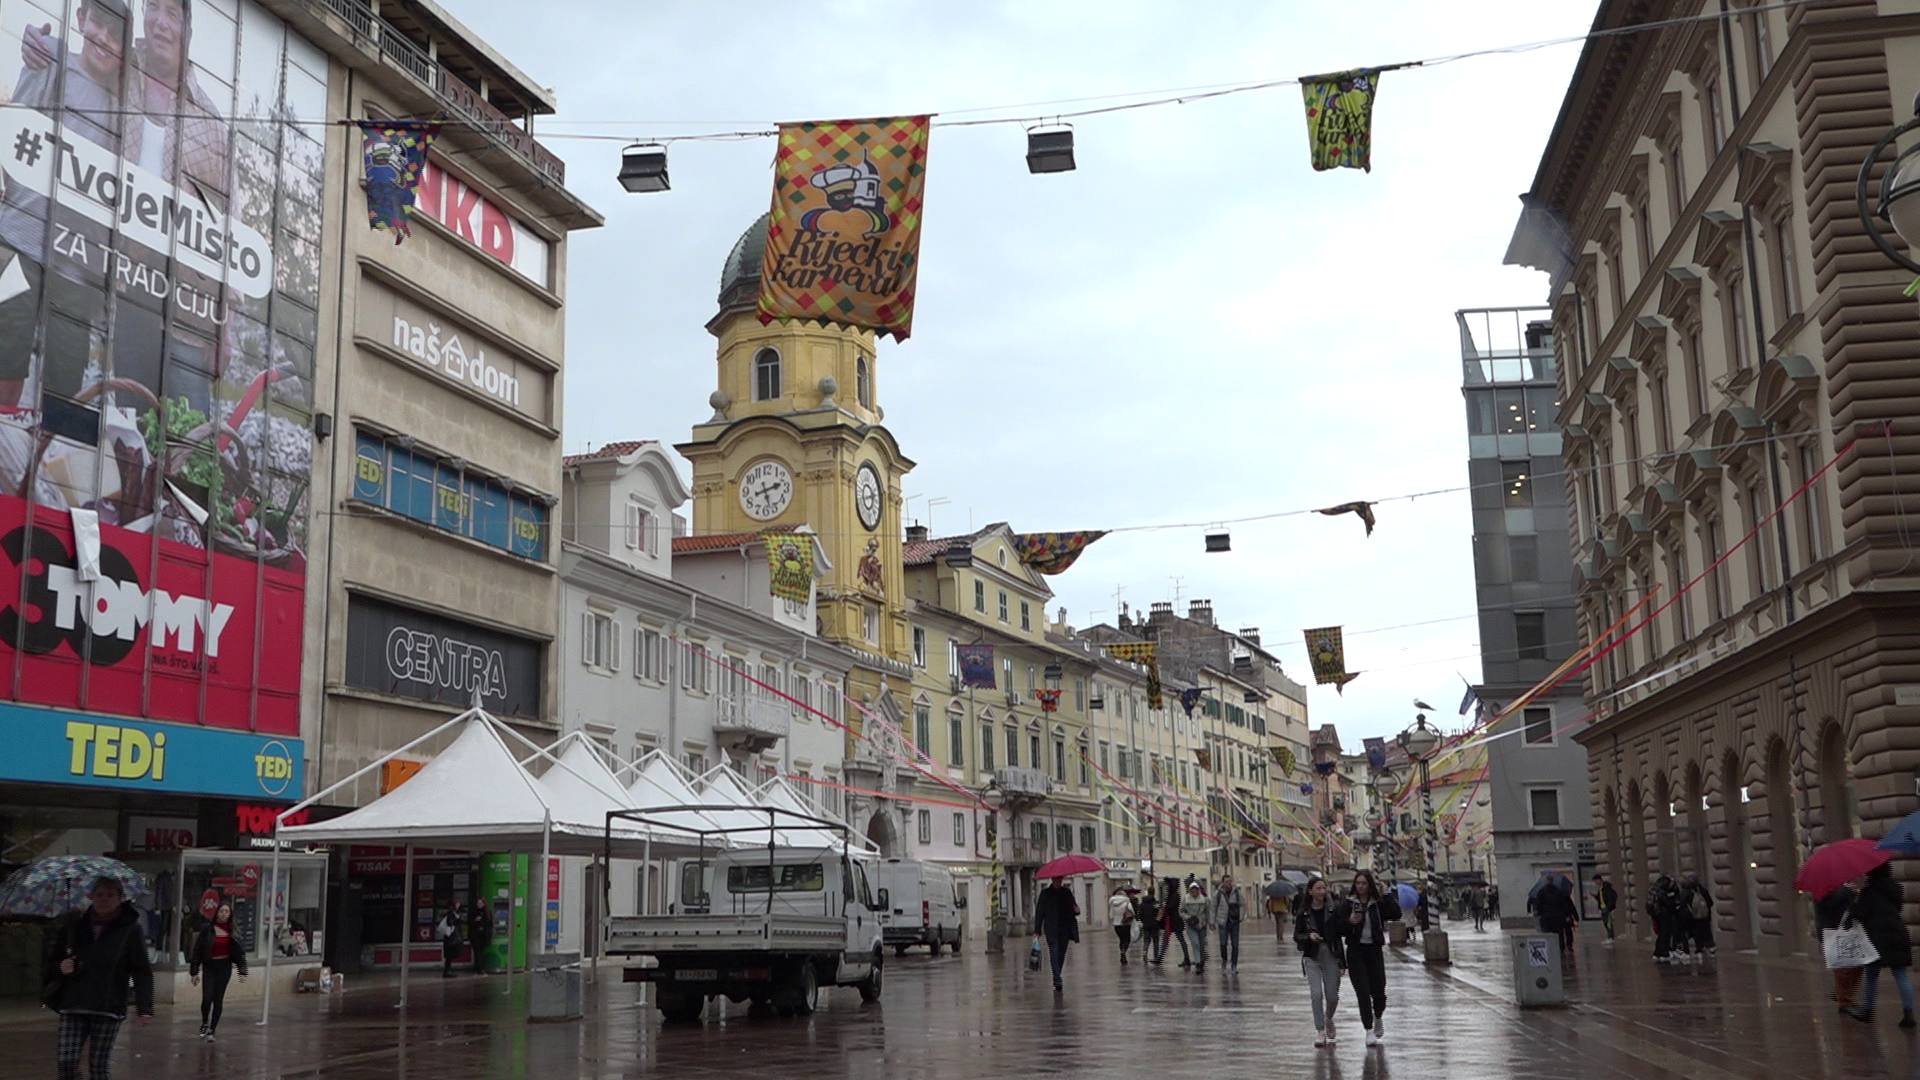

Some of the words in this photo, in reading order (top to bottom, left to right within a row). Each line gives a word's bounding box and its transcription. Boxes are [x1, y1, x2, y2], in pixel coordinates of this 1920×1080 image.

[14, 127, 261, 279] #TvojeMisto
[53, 223, 88, 265] ZA
[98, 243, 229, 325] TRADICIJU
[769, 253, 906, 298] karneval
[787, 228, 902, 278] Rijecki
[393, 316, 441, 366] naš
[469, 351, 519, 406] dom
[514, 516, 539, 542] TEDi
[47, 563, 235, 658] TOMMY
[386, 626, 507, 699] CENTRA
[66, 721, 166, 781] TEDi
[255, 754, 293, 780] TEDi
[145, 828, 194, 850] NKD
[356, 861, 392, 872] TISAK
